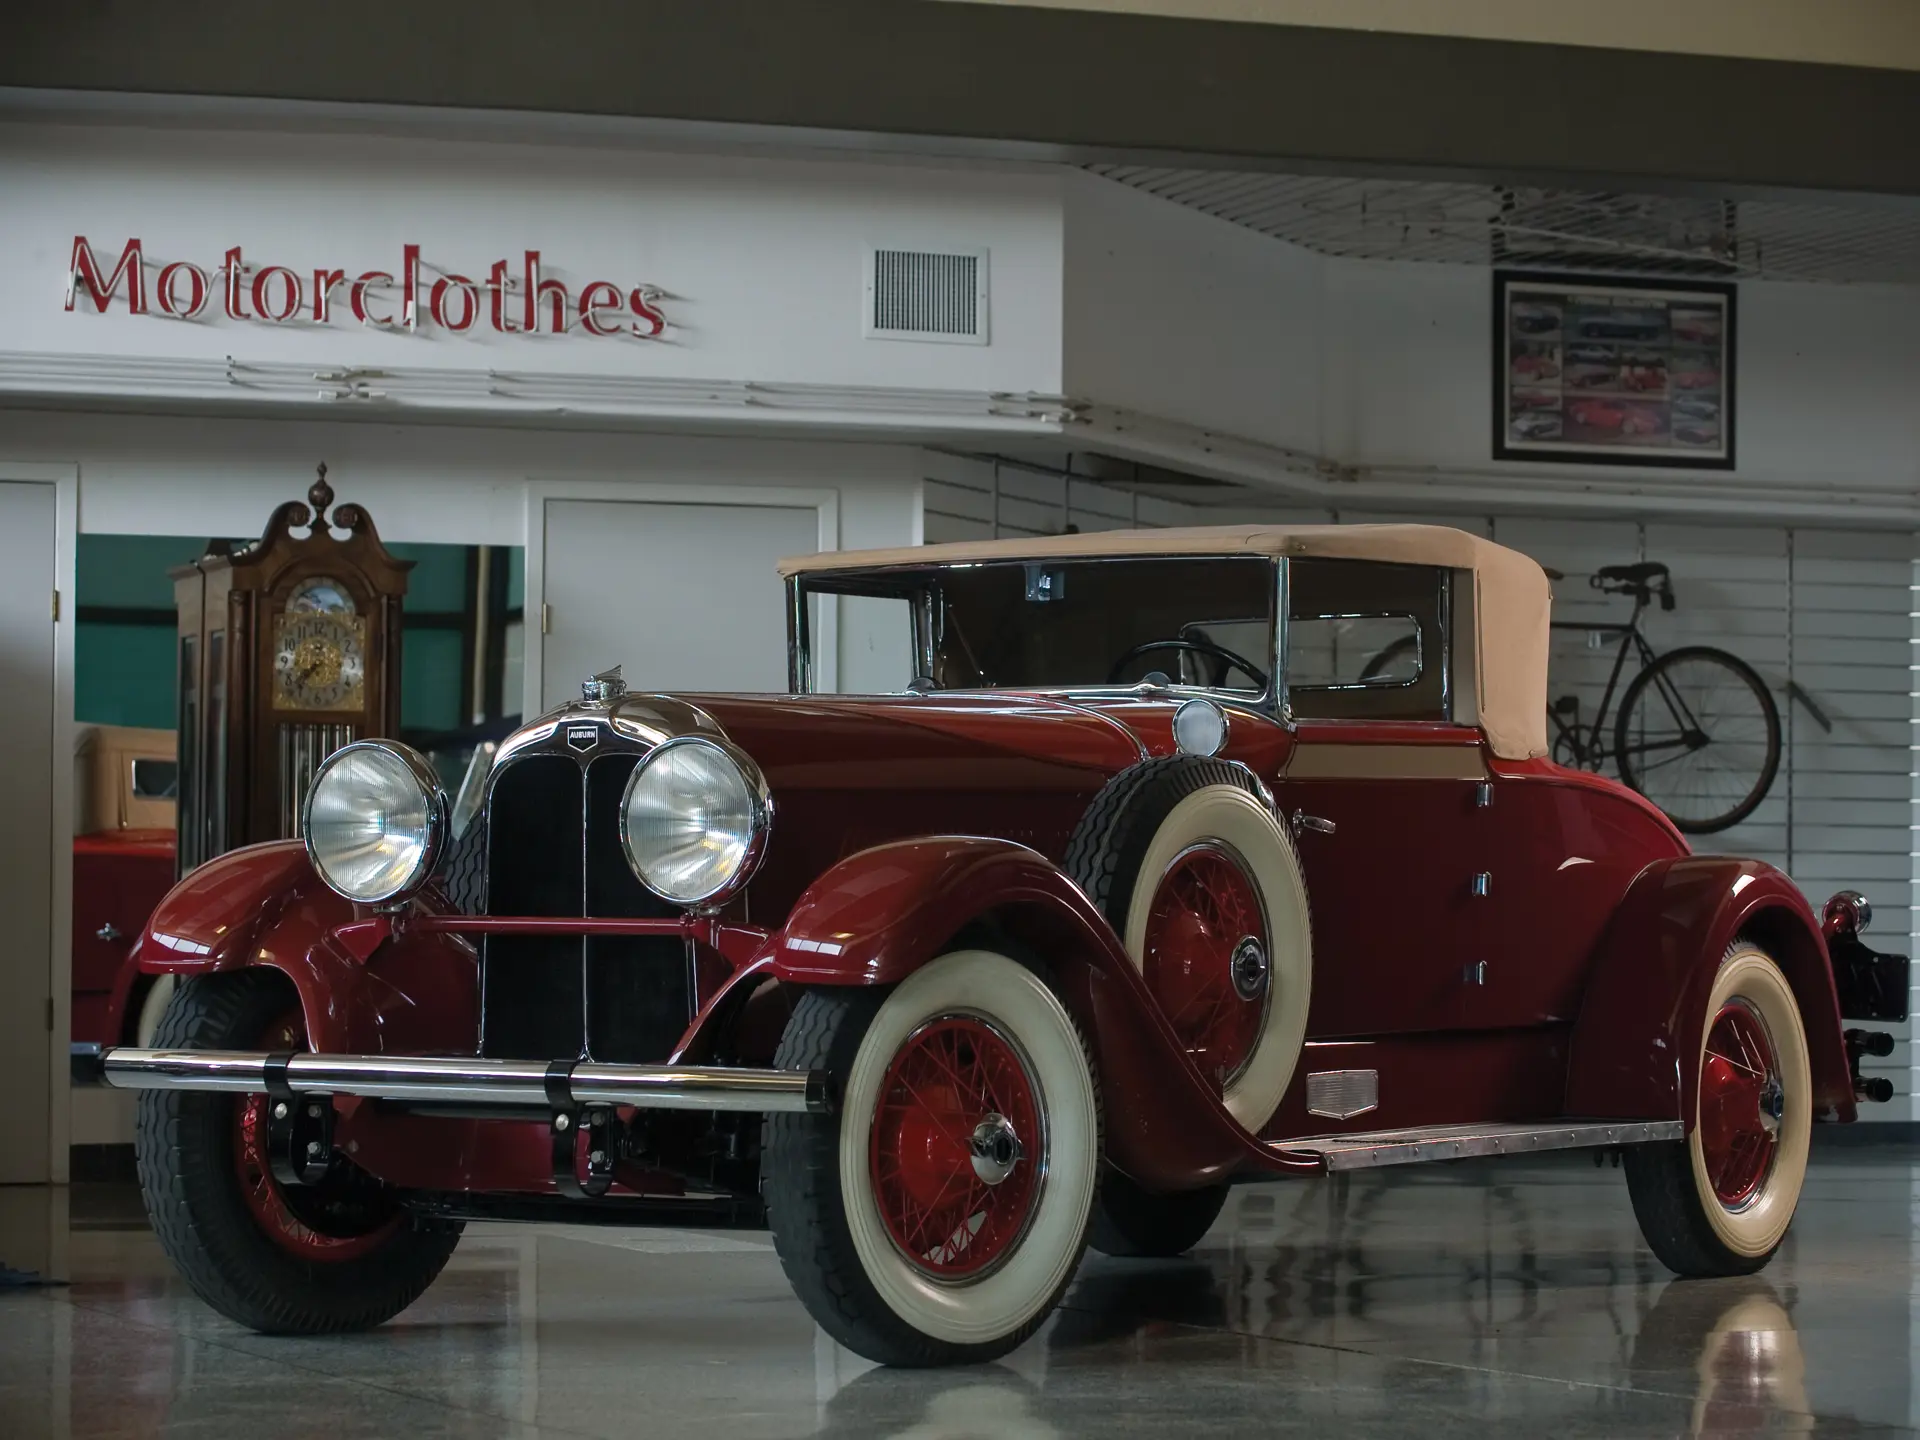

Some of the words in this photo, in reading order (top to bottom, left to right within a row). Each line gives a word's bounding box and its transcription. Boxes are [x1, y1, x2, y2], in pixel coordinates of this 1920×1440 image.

[64, 235, 670, 338] Motorclothes
[298, 625, 306, 639] 11
[314, 621, 324, 635] 12
[333, 626, 338, 640] 1
[284, 638, 296, 651] 10
[344, 639, 352, 653] 2
[280, 655, 288, 669] 9
[348, 656, 356, 669] 3
[285, 672, 293, 686] 8
[314, 691, 322, 705] 6
[569, 730, 596, 739] AUBURN
